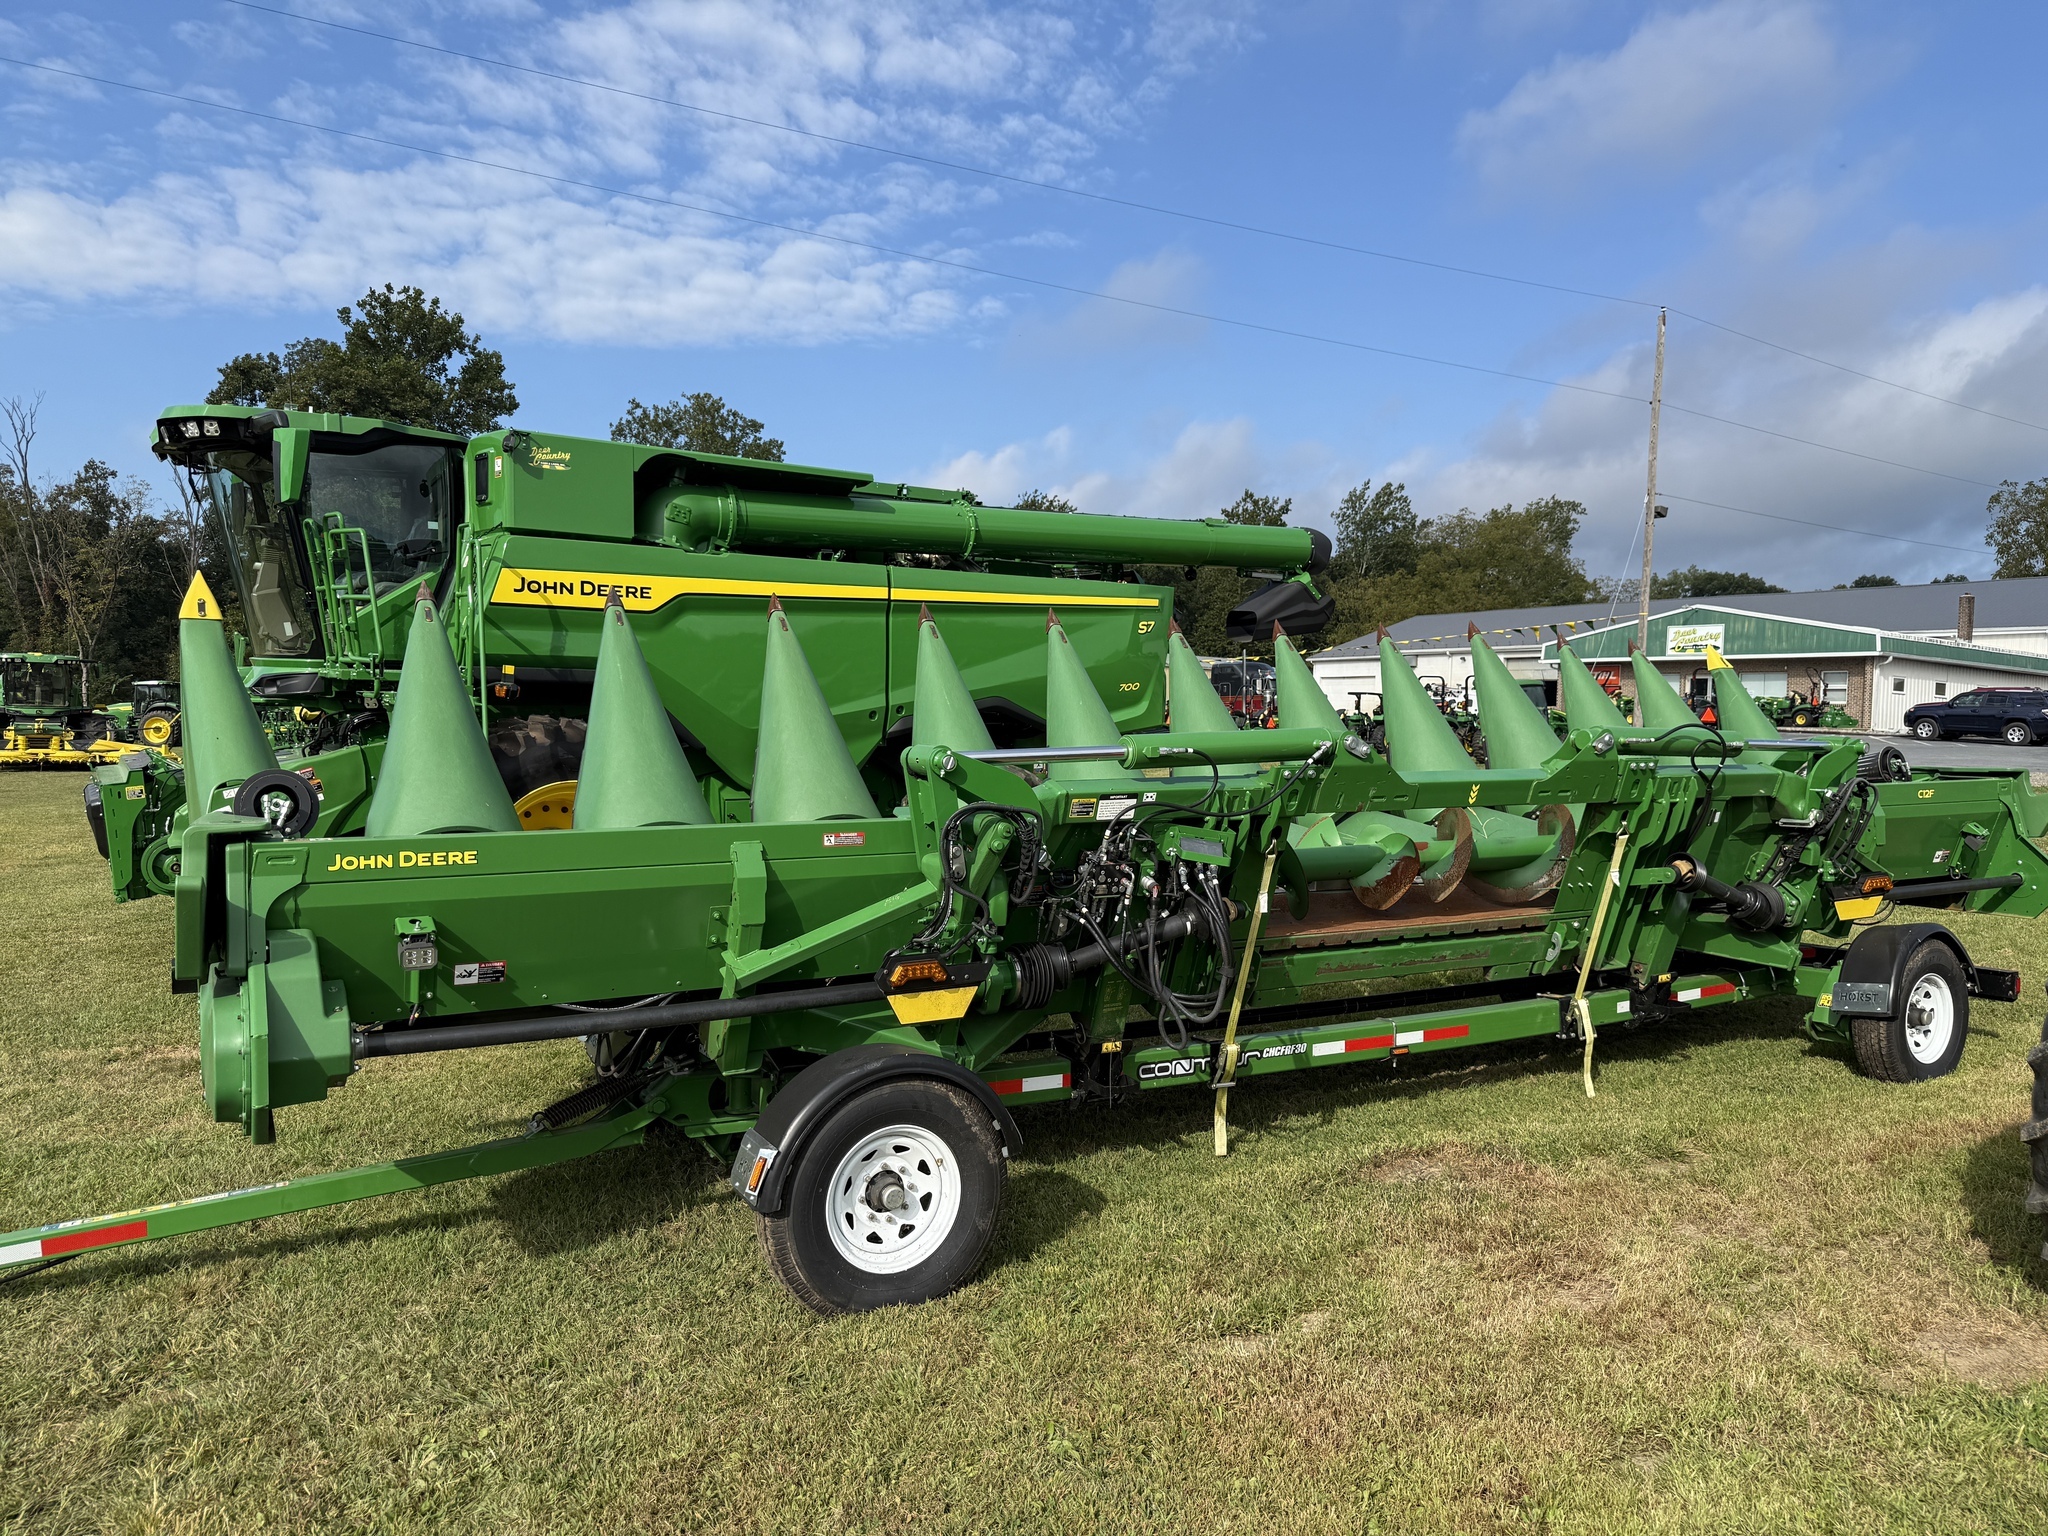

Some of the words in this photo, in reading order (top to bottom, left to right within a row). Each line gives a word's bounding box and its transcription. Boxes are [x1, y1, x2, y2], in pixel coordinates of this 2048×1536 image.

[533, 451, 571, 466] Country
[513, 576, 574, 596] JOHN
[580, 580, 652, 599] DEERE
[1137, 620, 1155, 635] S7
[1674, 631, 1722, 652] Country
[1592, 670, 1617, 680] TIHL
[1118, 682, 1141, 692] 700
[1917, 789, 1936, 799] C12F
[327, 853, 393, 872] JOHN
[399, 850, 478, 868] DEERE
[1840, 992, 1879, 1002] HORST
[1262, 1042, 1308, 1058] CHCFRF30
